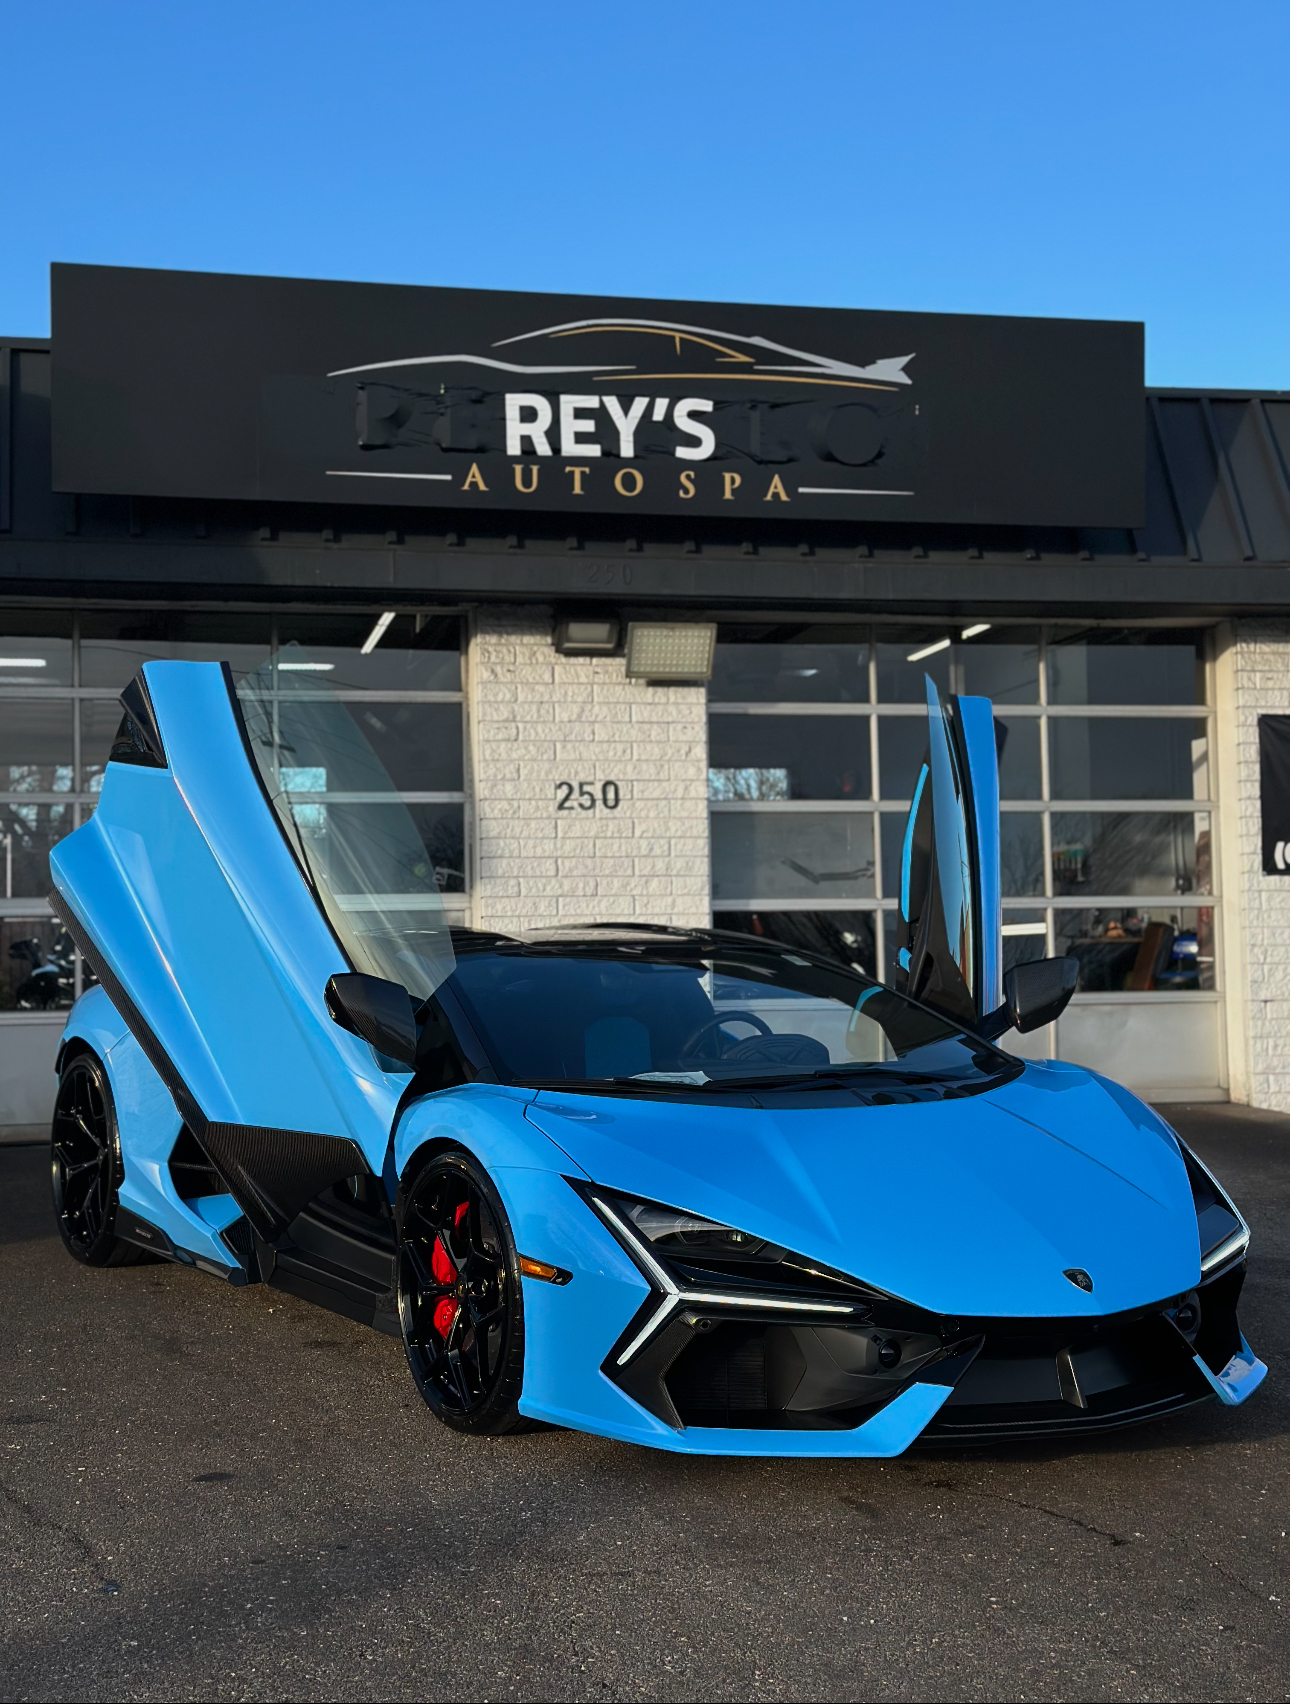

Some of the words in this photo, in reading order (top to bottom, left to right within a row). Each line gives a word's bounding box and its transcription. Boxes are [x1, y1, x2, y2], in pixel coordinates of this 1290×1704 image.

[504, 393, 716, 461] REY'S
[586, 562, 634, 587] 250
[556, 780, 620, 811] 250
